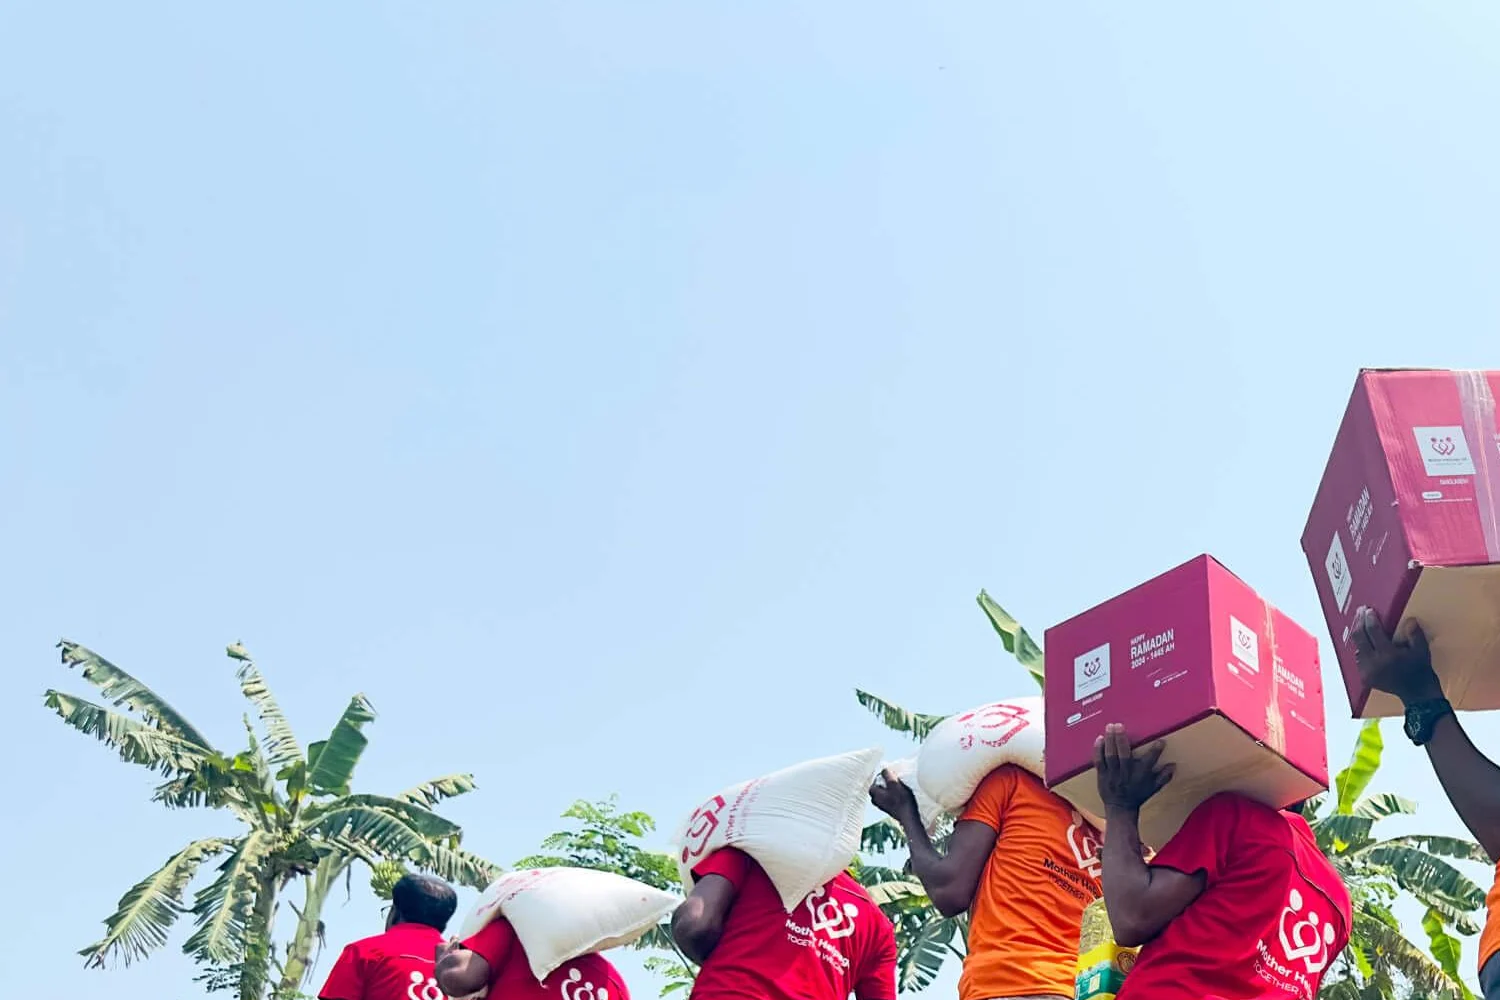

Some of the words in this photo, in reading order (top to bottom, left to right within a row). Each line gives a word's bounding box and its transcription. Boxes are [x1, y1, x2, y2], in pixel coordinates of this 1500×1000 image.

[1130, 627, 1175, 660] RAMADAN
[1165, 642, 1175, 655] AH
[785, 919, 817, 942] Moth
[818, 938, 850, 971] Helpag
[1256, 938, 1293, 977] Mother
[1253, 959, 1299, 995] TOGETHER
